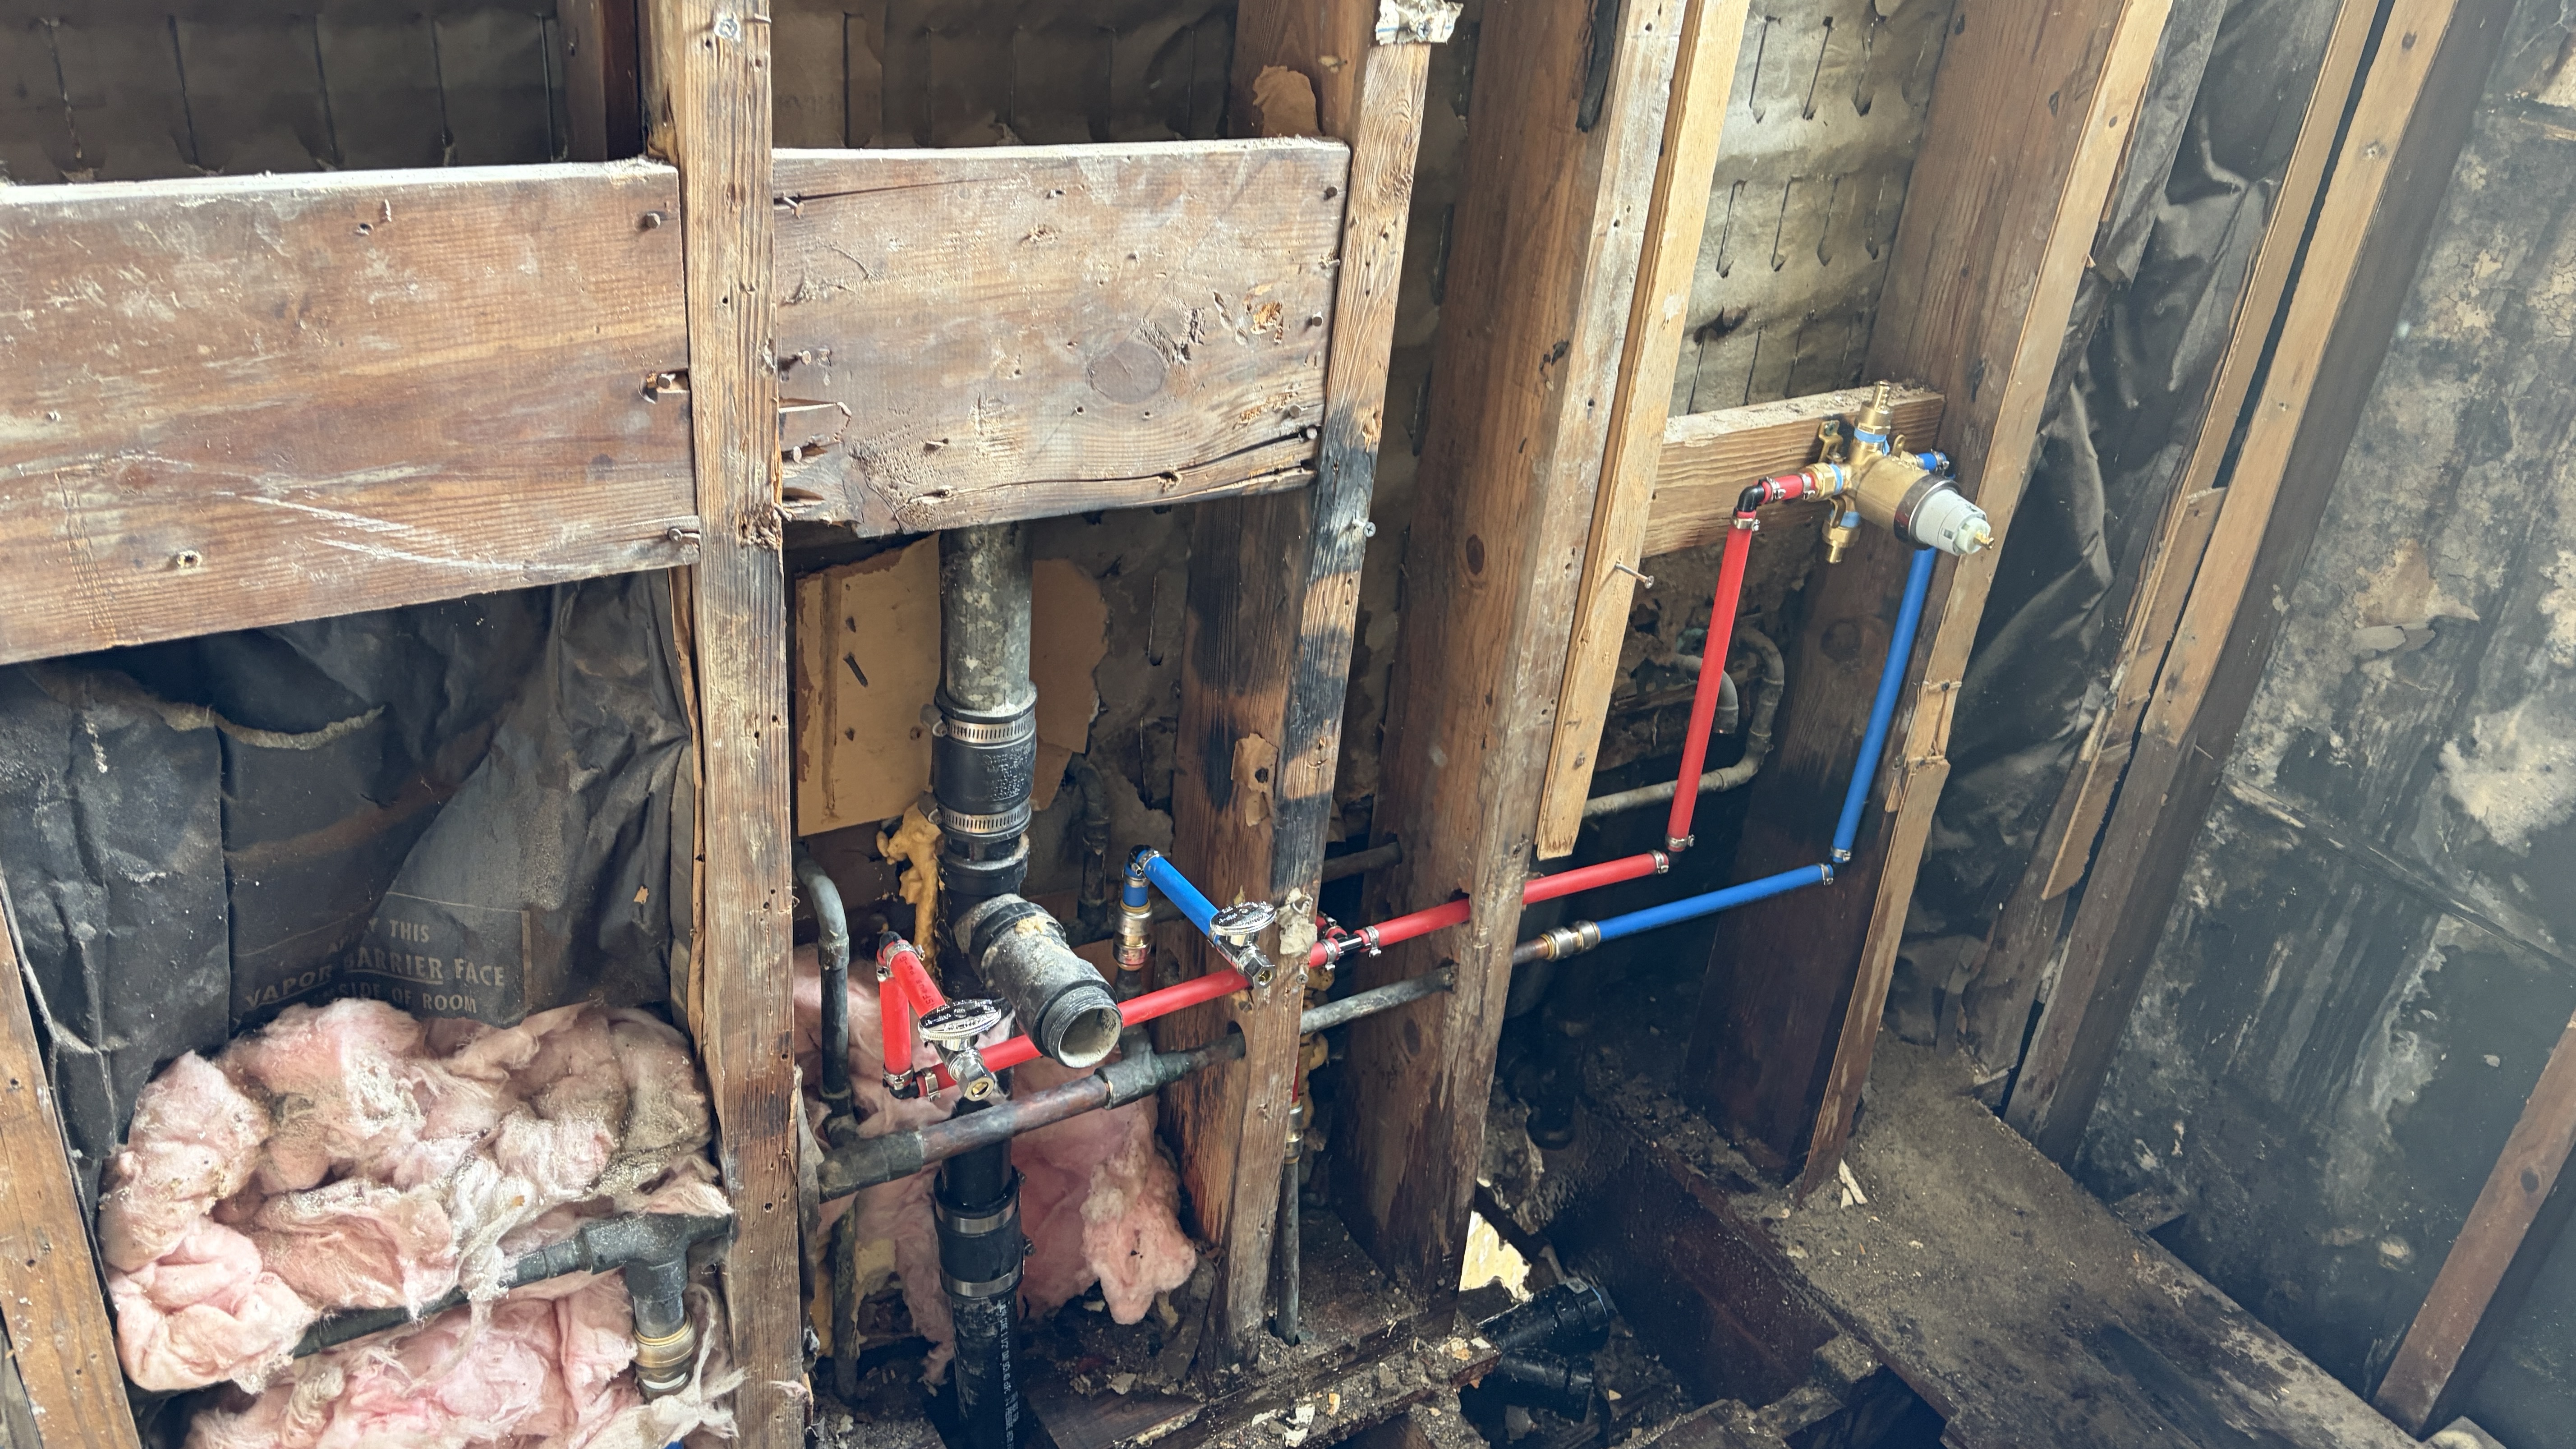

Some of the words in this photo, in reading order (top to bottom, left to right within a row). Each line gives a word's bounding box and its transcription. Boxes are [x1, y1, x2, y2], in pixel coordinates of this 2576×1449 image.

[389, 919, 429, 943] THIS
[245, 965, 332, 1007] VAPOR
[454, 958, 504, 987] FACE
[391, 988, 411, 1005] OF
[423, 993, 477, 1014] ROOM
